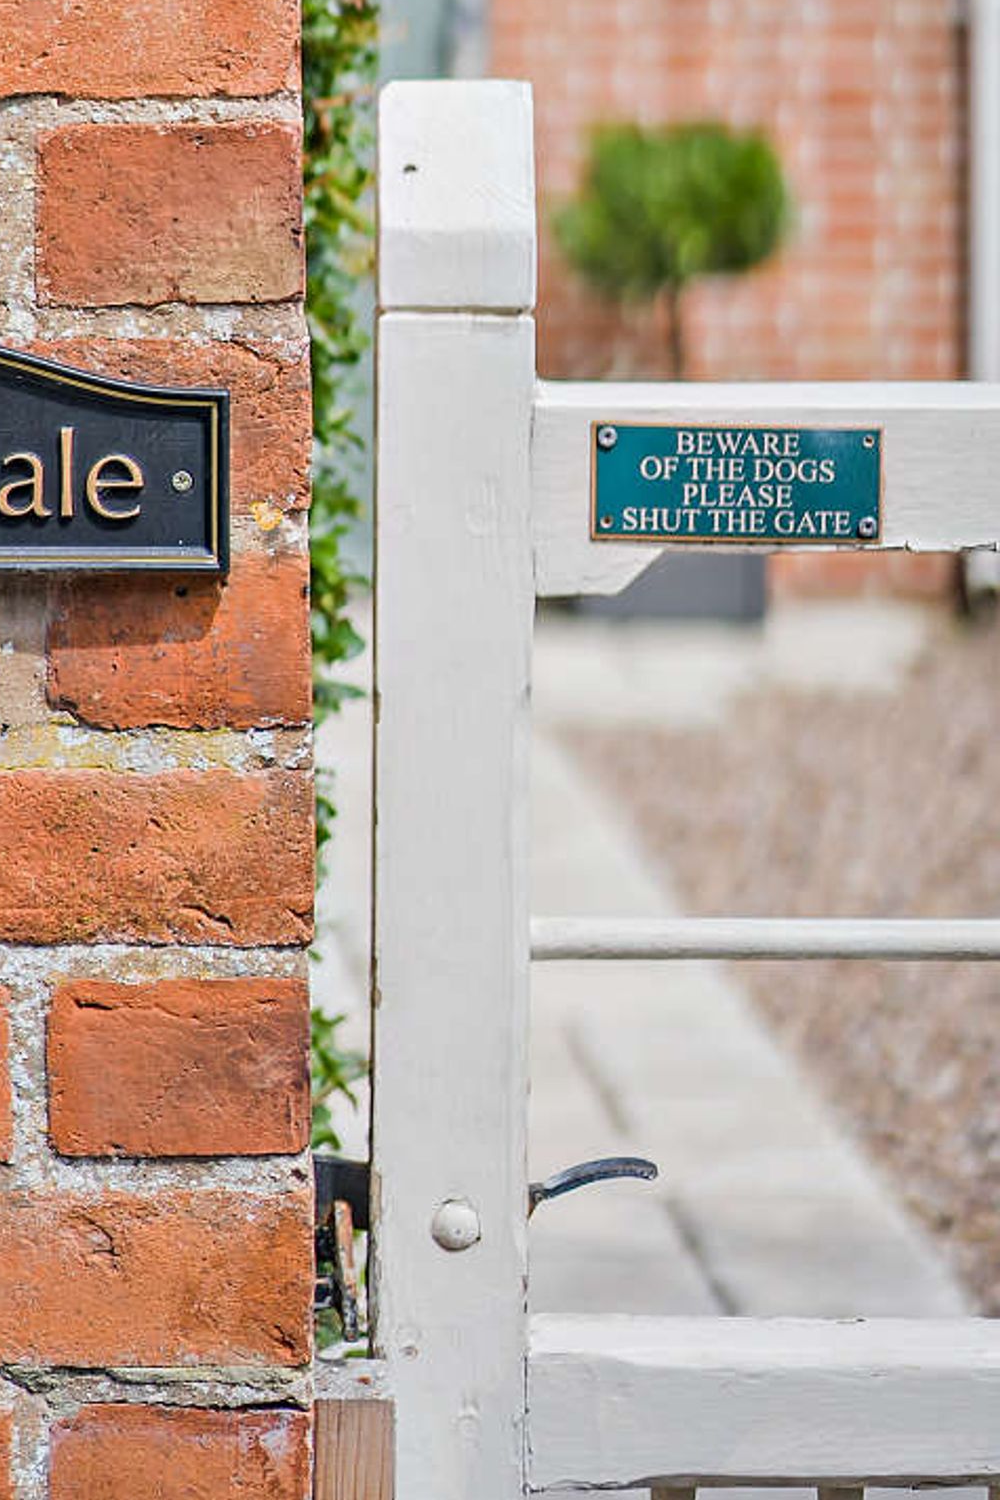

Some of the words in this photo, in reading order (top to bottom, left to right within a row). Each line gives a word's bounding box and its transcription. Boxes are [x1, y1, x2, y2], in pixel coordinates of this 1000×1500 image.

[676, 431, 800, 457] BEWARE
[640, 456, 678, 480] OF
[687, 457, 745, 482] THE
[753, 459, 836, 483] DOGS
[683, 484, 793, 508] PLEASE
[622, 507, 701, 532] SHUT
[708, 509, 767, 533] THE
[774, 510, 852, 535] GATE
